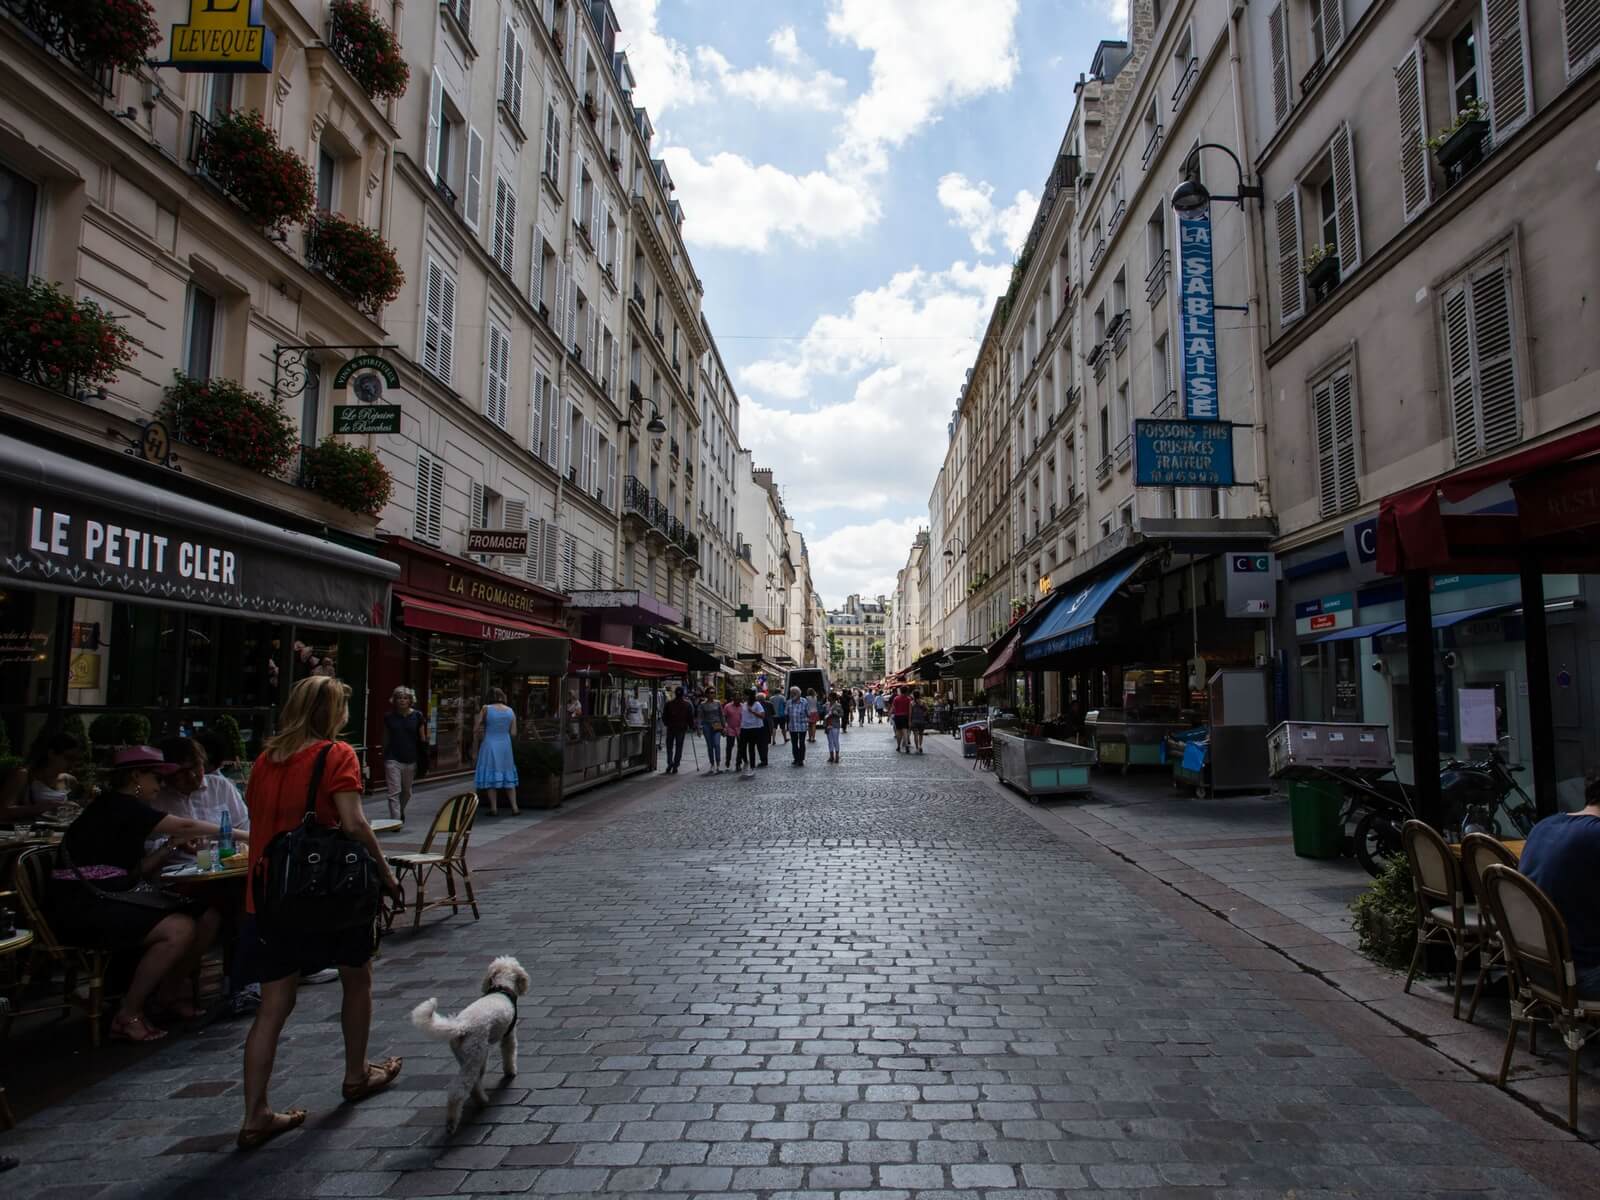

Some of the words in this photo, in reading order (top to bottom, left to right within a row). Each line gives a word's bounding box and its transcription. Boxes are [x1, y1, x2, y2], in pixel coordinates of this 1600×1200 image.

[179, 29, 258, 56] LEVEQUE
[1182, 226, 1209, 243] LA
[1185, 257, 1217, 417] SABLAISE
[31, 507, 71, 556] LE
[85, 520, 168, 573] PETIT
[178, 541, 236, 585] CLER
[469, 535, 527, 551] FROMAGER
[448, 575, 464, 593] LA
[471, 581, 535, 613] FROMAGERIE
[481, 624, 492, 640] LA
